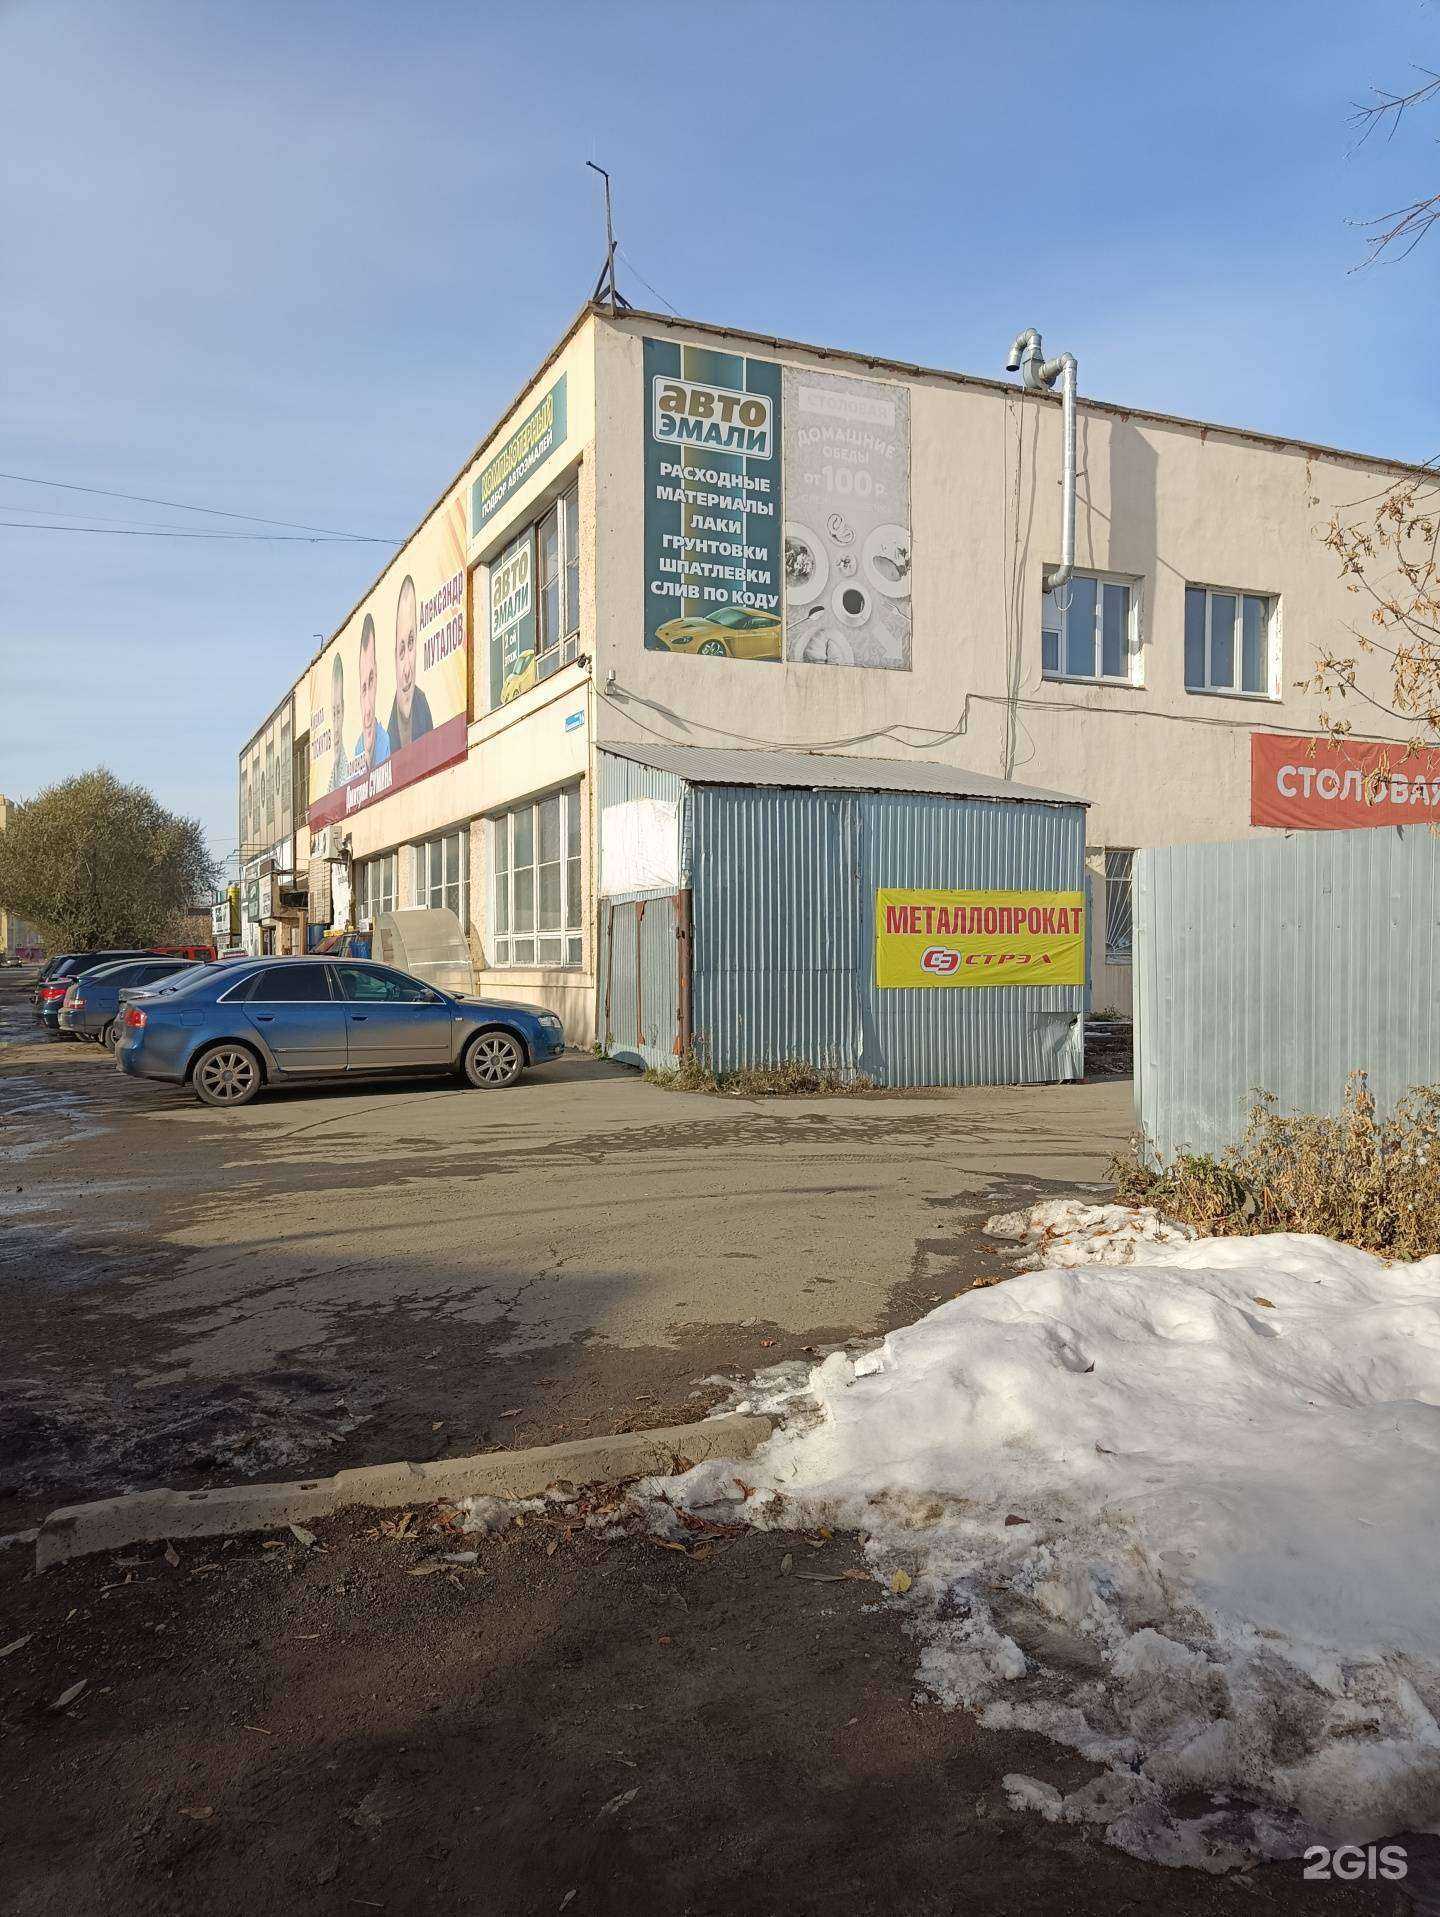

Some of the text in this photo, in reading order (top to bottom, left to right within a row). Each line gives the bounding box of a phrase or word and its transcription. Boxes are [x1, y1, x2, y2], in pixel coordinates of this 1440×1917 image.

[481, 393, 554, 501] КОМПЬЮТЕРНЫЙ
[658, 413, 767, 453] ЭМАЛИ
[822, 446, 870, 464] ОБЕДЫ
[482, 428, 553, 518] ПОДБОР АВТОЭМАЛЕЙ
[660, 462, 771, 493] РАСХОДНЫЕ
[822, 465, 872, 497] 100
[656, 486, 774, 516] МАТЕРИАЛЫ
[690, 514, 742, 534] ЛАКИ
[662, 534, 768, 561] ГРУНТОВКИ
[659, 557, 771, 584] ШПАТЛЕВКИ
[493, 582, 529, 633] ЭМАЛИ
[650, 580, 779, 608] СЛИВ ПО КОДУ
[423, 612, 463, 671] МУТАЛОВ
[886, 905, 1083, 935] МЕТАЛЛОПРОКАТ
